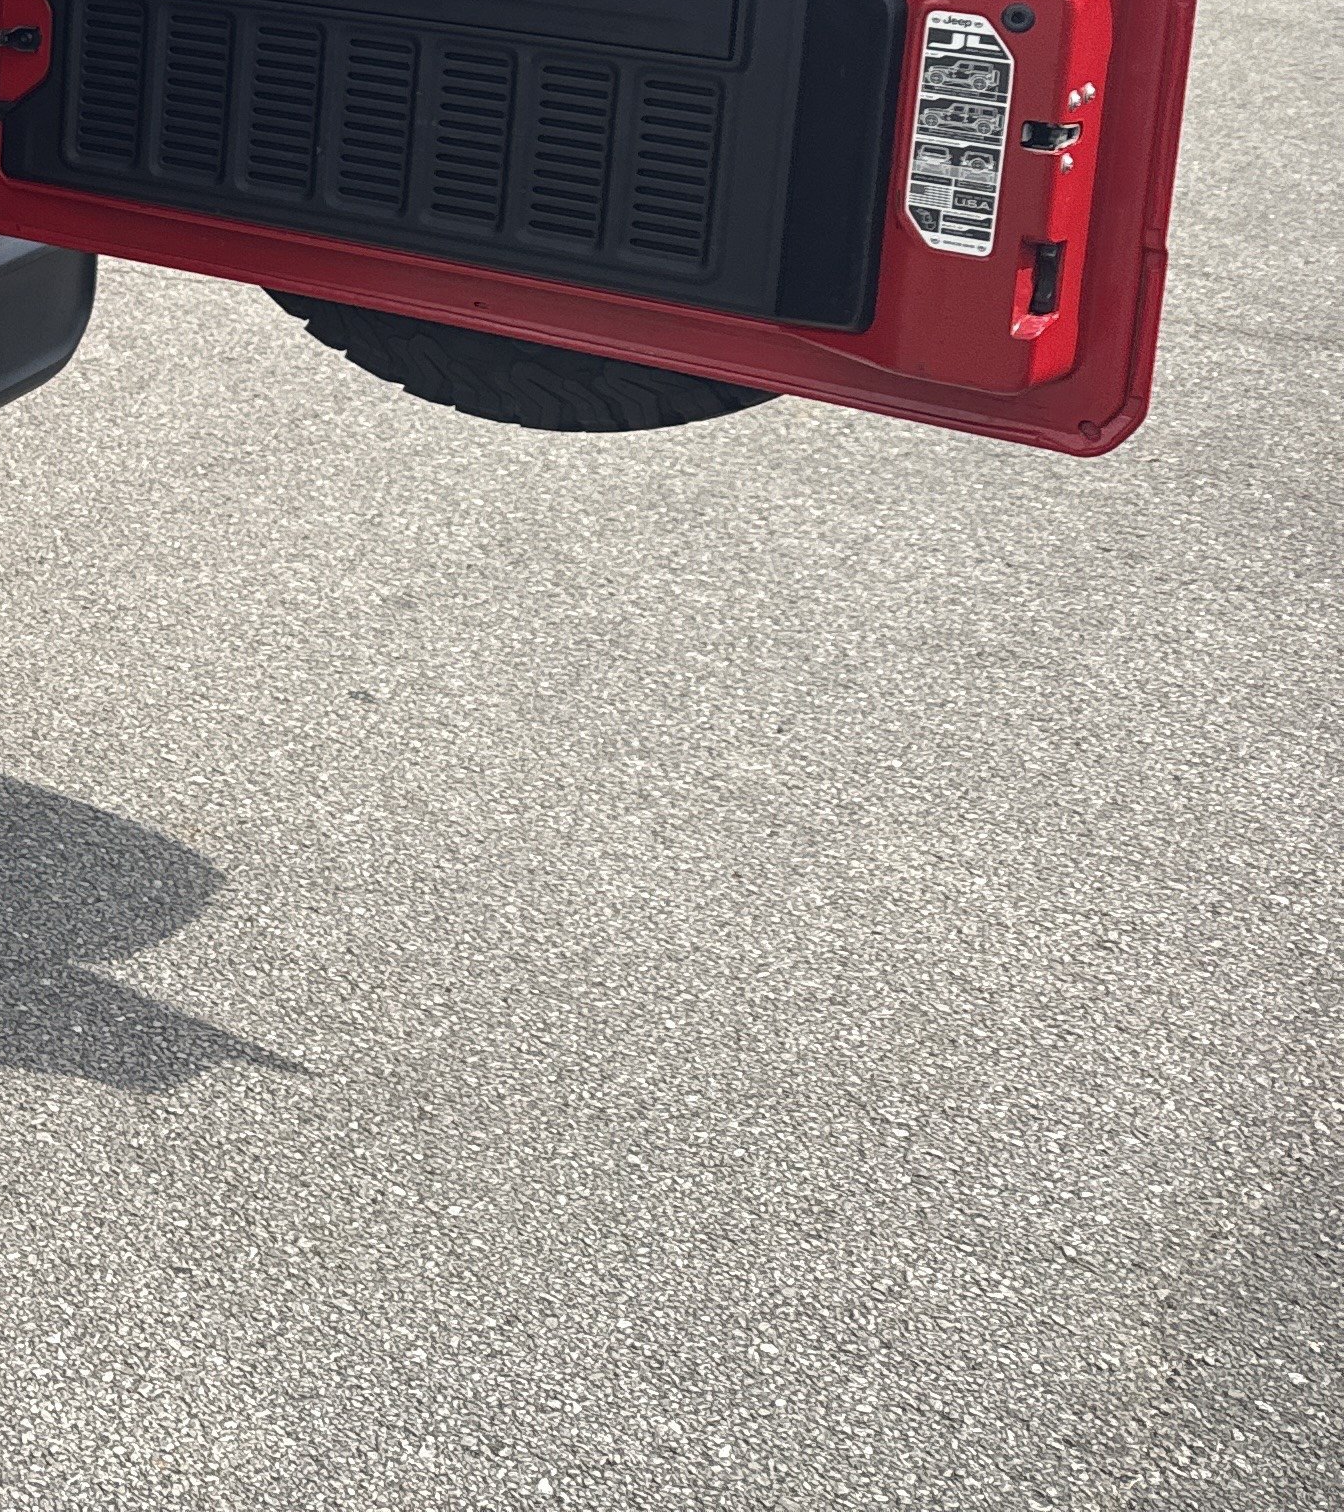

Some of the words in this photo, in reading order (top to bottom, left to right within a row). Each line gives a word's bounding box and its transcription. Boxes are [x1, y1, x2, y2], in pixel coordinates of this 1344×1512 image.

[942, 15, 972, 28] Jeep
[927, 32, 1002, 52] JL
[953, 197, 992, 211] USA
